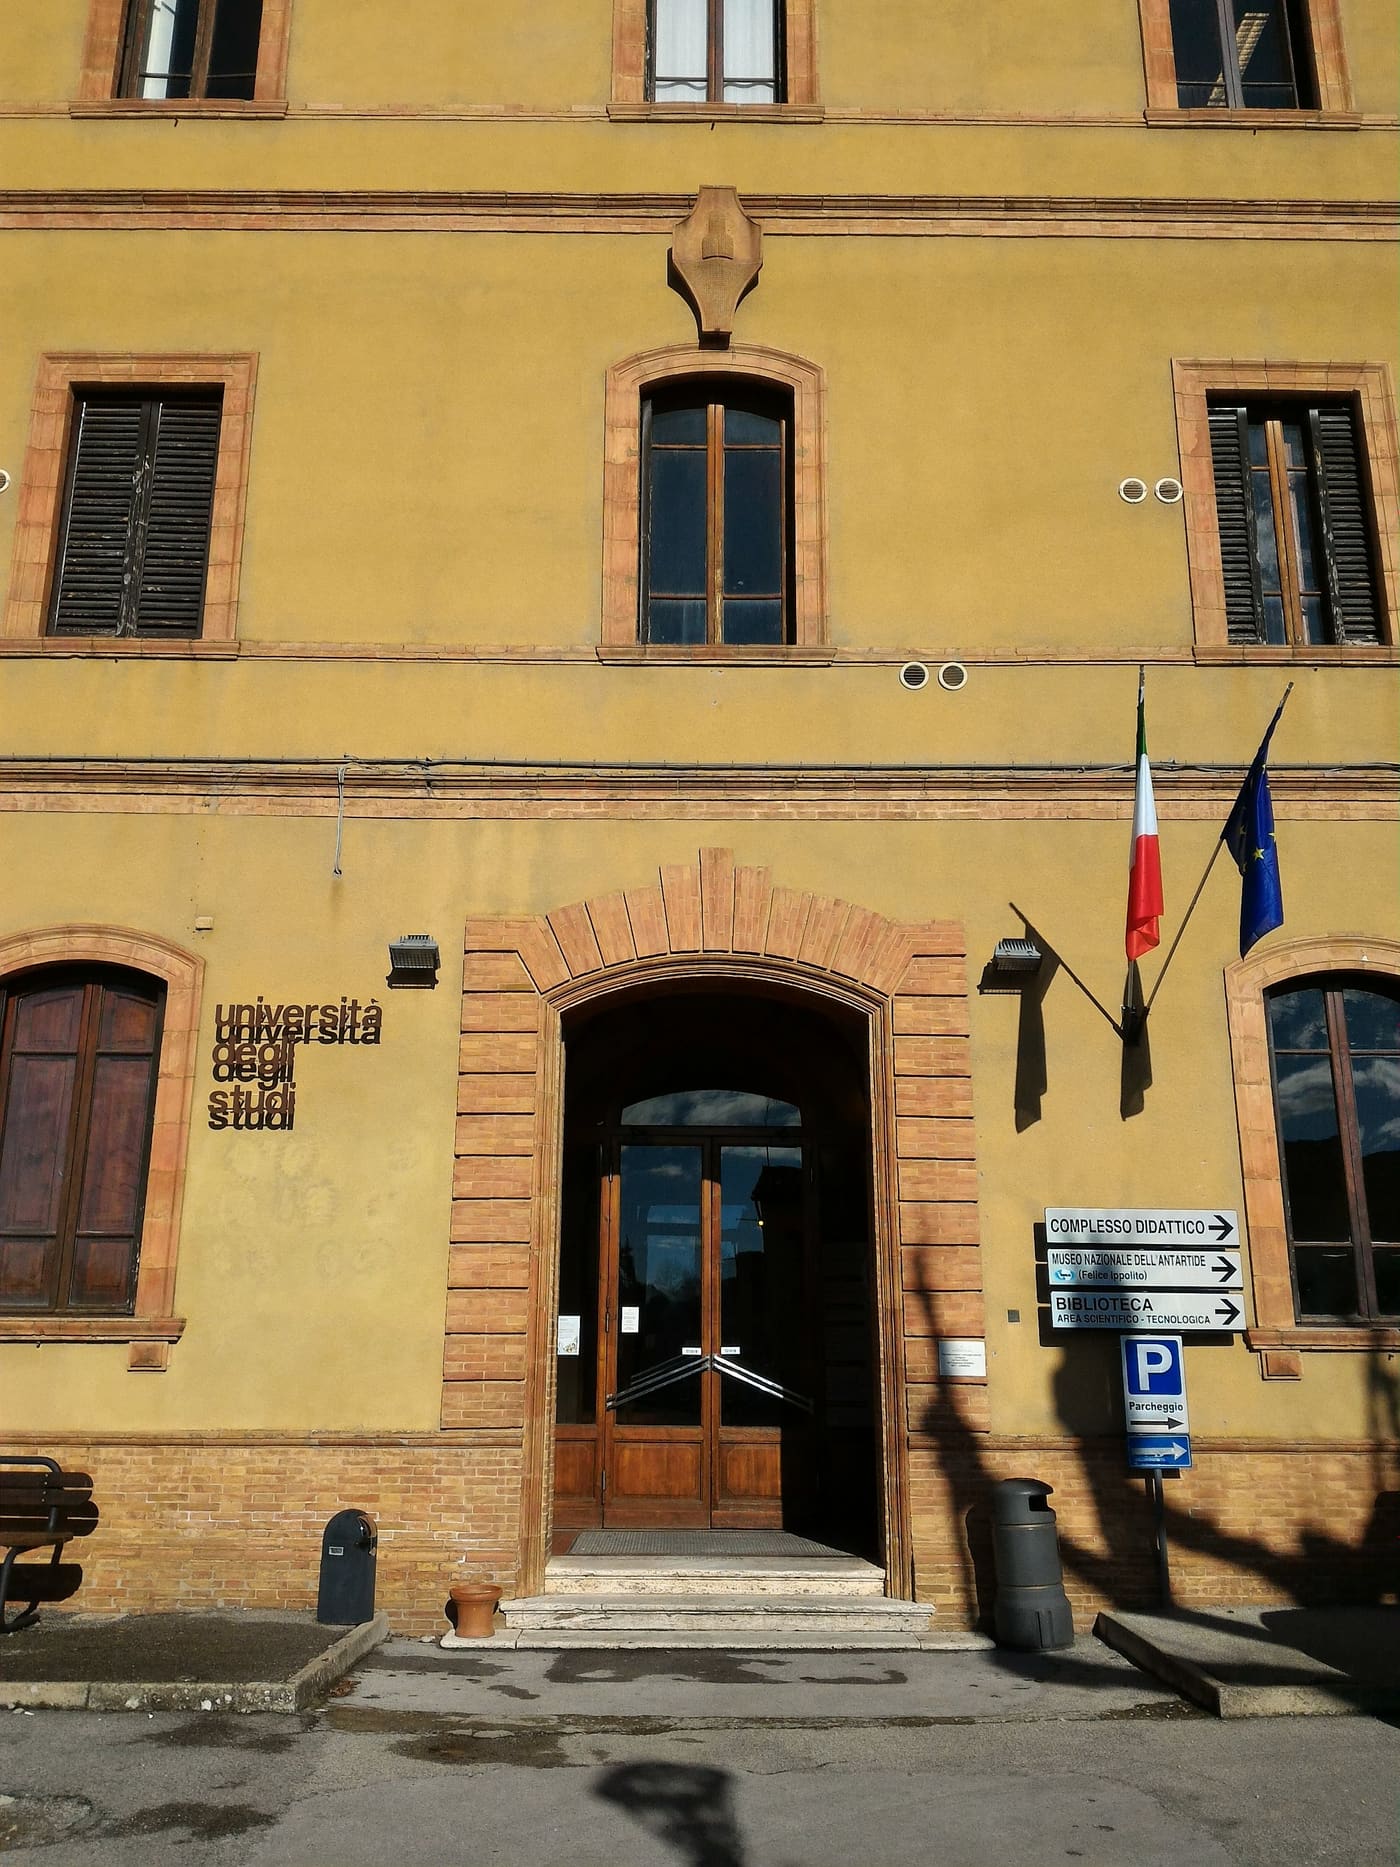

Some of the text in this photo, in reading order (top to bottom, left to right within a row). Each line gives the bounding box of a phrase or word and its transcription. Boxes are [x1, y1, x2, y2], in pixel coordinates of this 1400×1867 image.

[215, 996, 383, 1028] università
[212, 1034, 296, 1076] degli
[208, 1082, 297, 1114] studi
[1050, 1218, 1206, 1235] COMPLESSO DIDATTICO
[1051, 1253, 1207, 1267] MUSEO NAZIONALE DELL'ANTARTIDE
[1078, 1269, 1148, 1284] (Felice Ippolito)
[1056, 1297, 1154, 1312] BIBLIOTECA
[1057, 1314, 1082, 1324] AREA
[1083, 1314, 1140, 1325] SCIENTIFICO
[1146, 1314, 1211, 1325] TECNOLOGICA
[1136, 1343, 1173, 1391] P
[1129, 1401, 1184, 1414] Parcheggio
